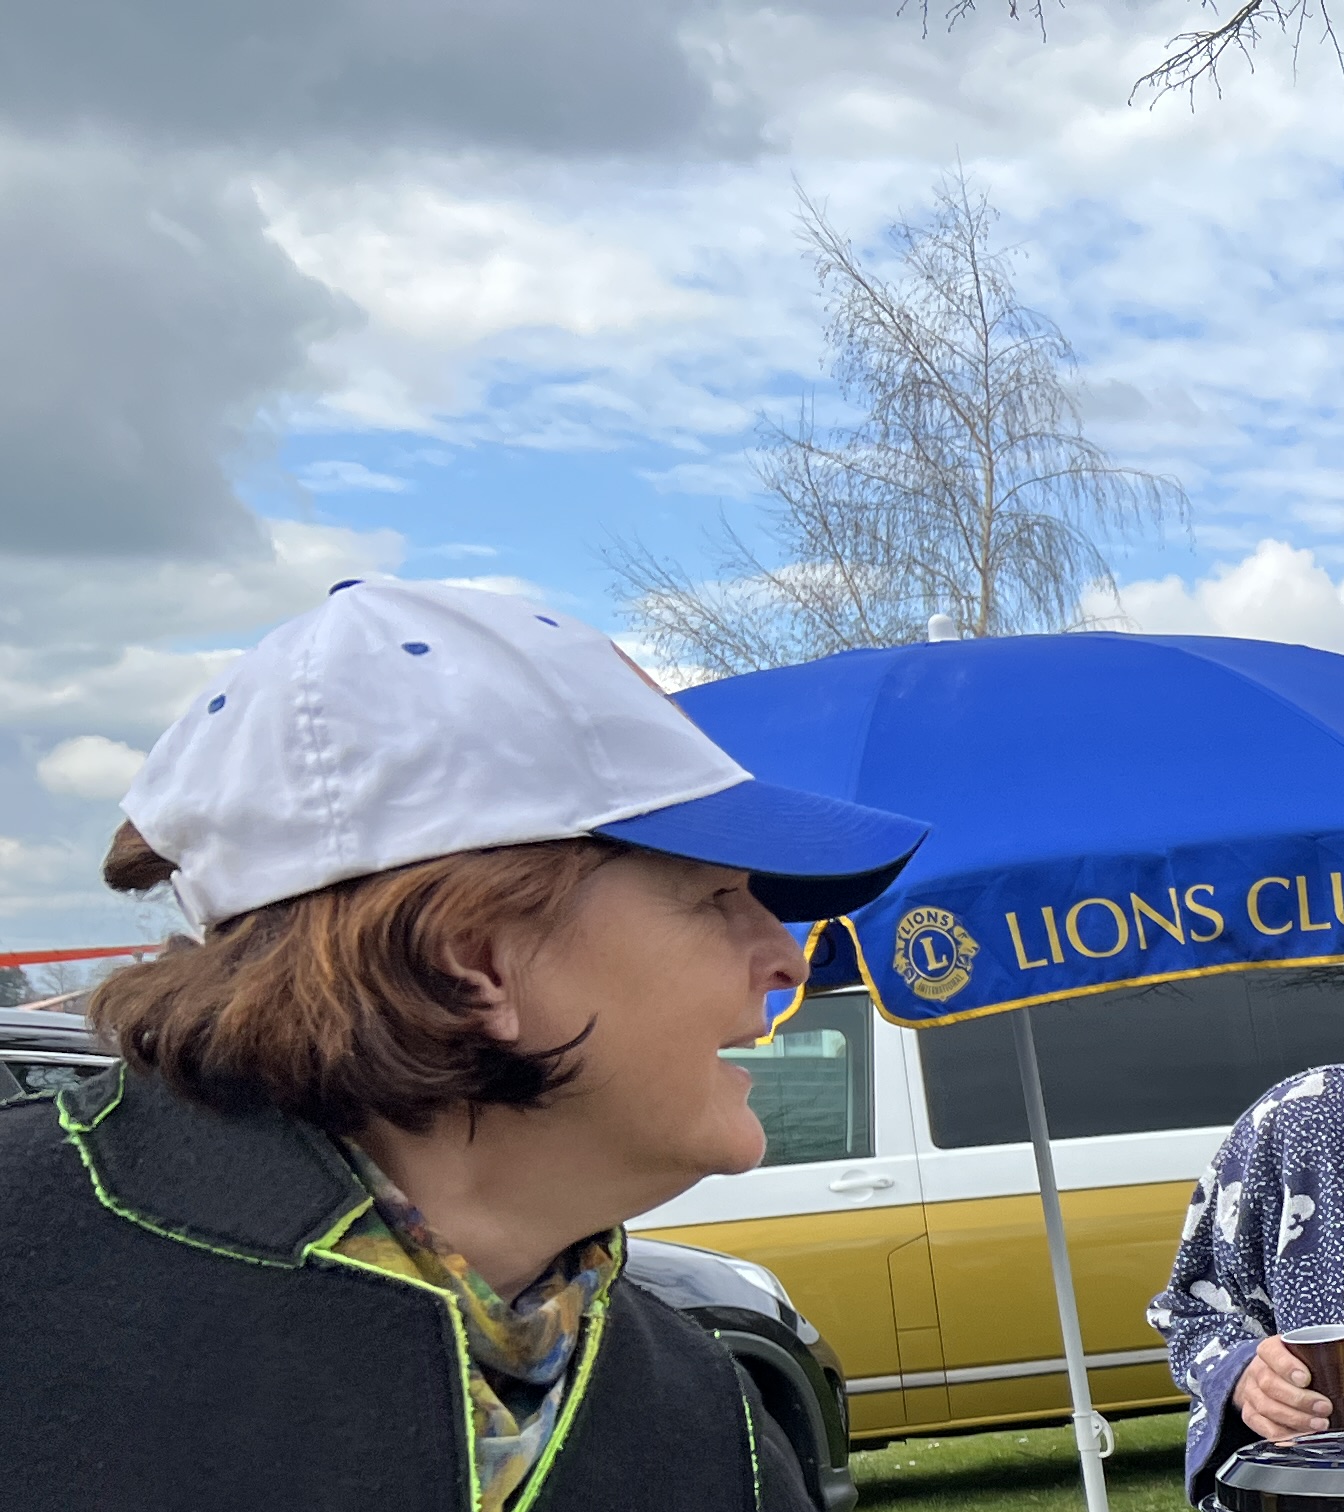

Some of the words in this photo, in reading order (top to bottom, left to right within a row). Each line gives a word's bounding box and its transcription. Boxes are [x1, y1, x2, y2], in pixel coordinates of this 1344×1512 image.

[900, 910, 950, 936] LIONS
[1005, 883, 1225, 971] LIONS
[920, 936, 949, 972] L
